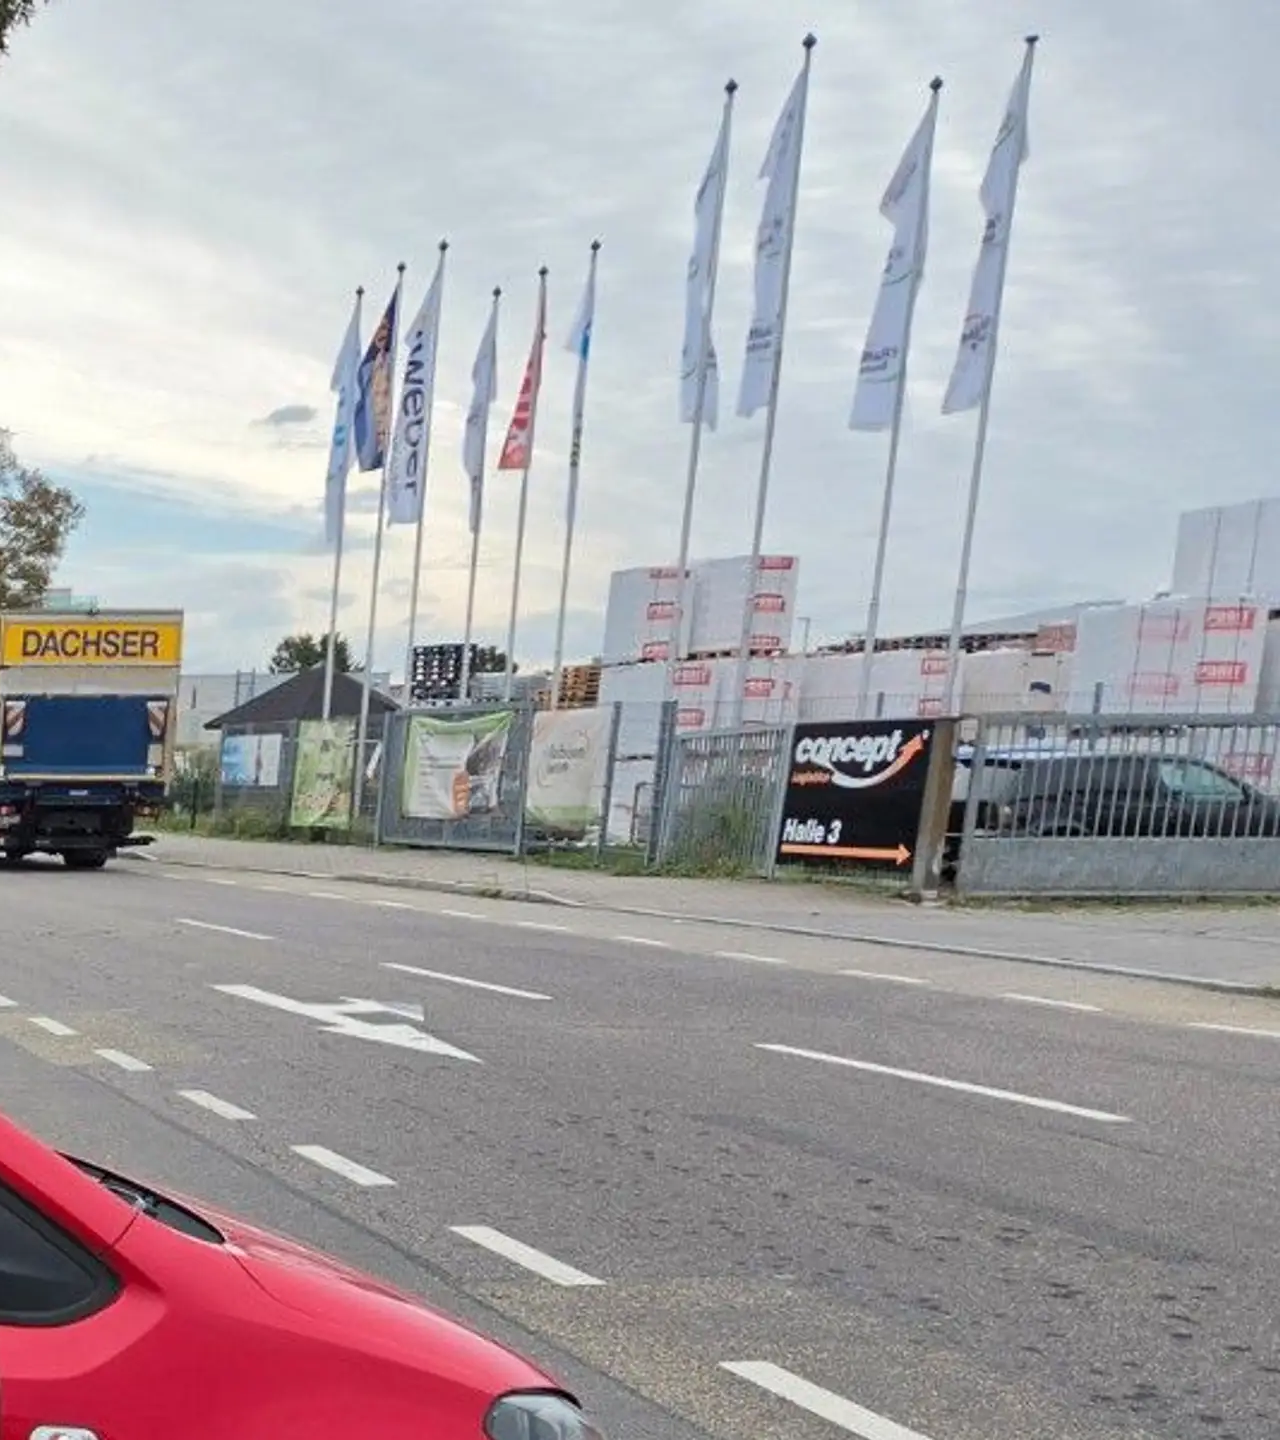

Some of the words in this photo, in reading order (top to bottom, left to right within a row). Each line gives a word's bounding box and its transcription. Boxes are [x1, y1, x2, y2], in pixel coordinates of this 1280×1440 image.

[21, 629, 160, 658] DACHSER
[795, 729, 903, 771] concept
[782, 818, 825, 843] Halle
[827, 819, 842, 843] 3
